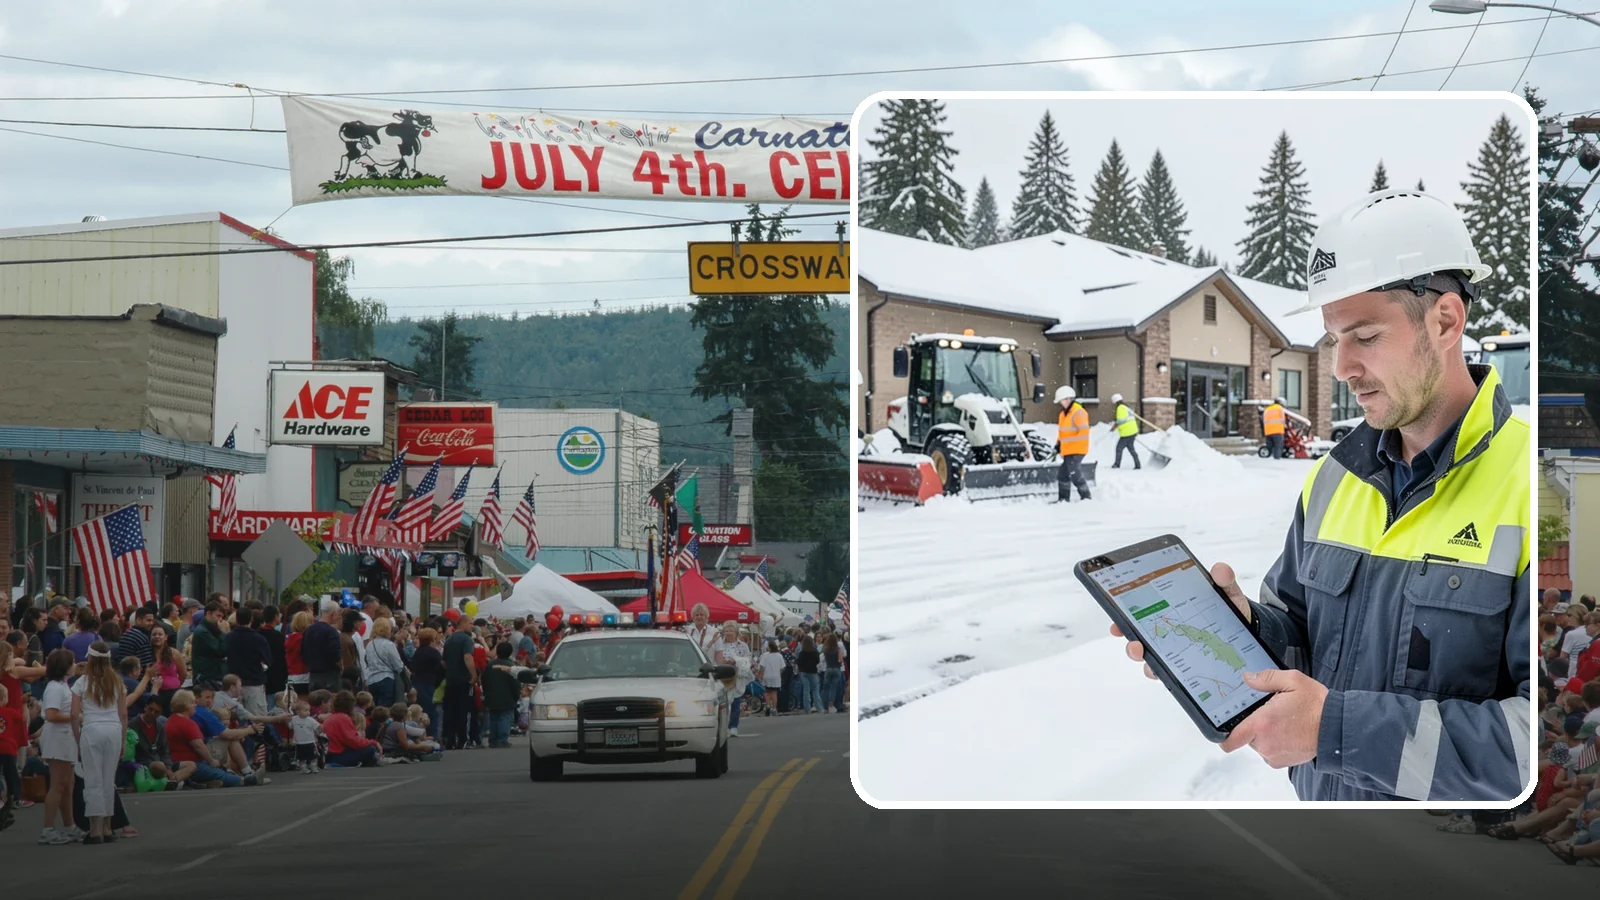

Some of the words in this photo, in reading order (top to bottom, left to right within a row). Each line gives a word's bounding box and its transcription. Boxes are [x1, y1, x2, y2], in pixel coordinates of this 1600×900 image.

[481, 141, 605, 192] JULY
[632, 150, 746, 198] 4th.
[697, 254, 850, 280] CROSSWA
[283, 380, 374, 420] ACE
[406, 409, 453, 422] CEDAR
[283, 421, 371, 437] Hardware
[96, 485, 124, 494] Vincent
[126, 486, 135, 494] de
[138, 486, 155, 495] Paul
[213, 516, 330, 535] HARDARE
[688, 526, 742, 535] CRNATION
[699, 535, 730, 543] GLASS
